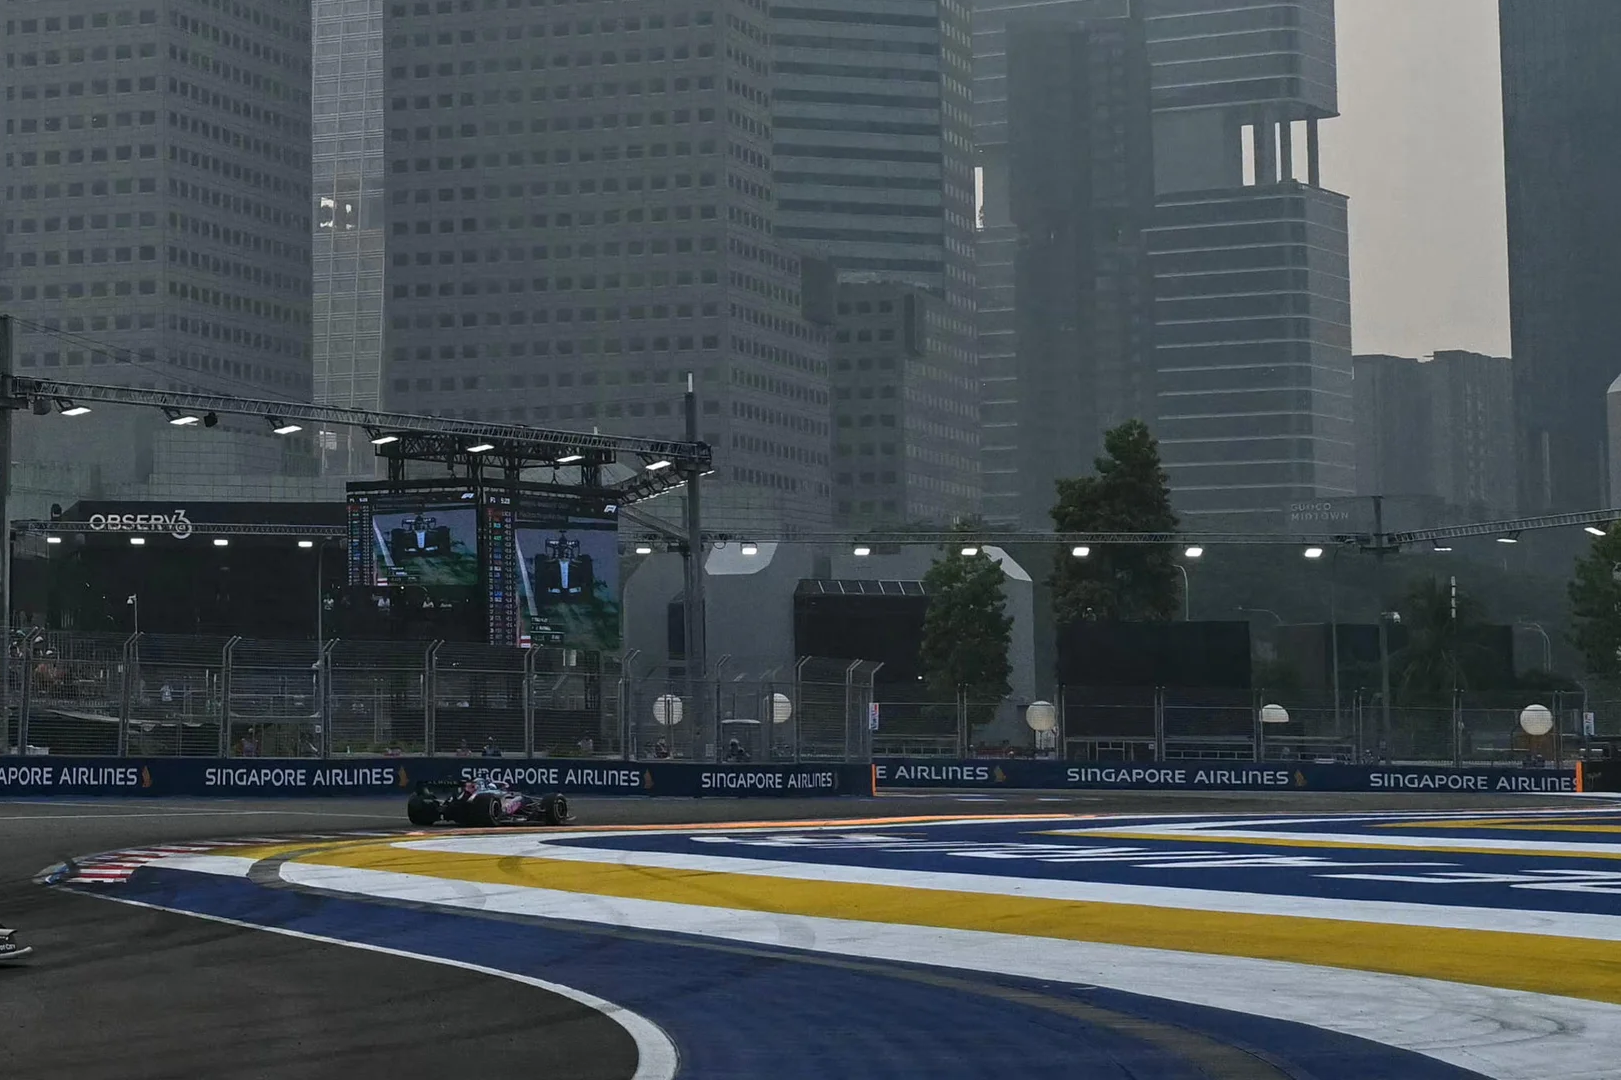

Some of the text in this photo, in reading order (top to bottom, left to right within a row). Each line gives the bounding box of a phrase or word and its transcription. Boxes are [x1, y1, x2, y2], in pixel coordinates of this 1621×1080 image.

[59, 767, 137, 786] AIRLINES
[206, 768, 394, 786] SINGAPORE AIRLINES
[564, 769, 639, 787] AIRLINES
[702, 772, 832, 789] SINGAPORE AIRLINES
[895, 766, 989, 780] AIRLINES
[1068, 768, 1289, 785] SINGAPORE AIRLINES
[1369, 773, 1488, 790] SINGAPORE
